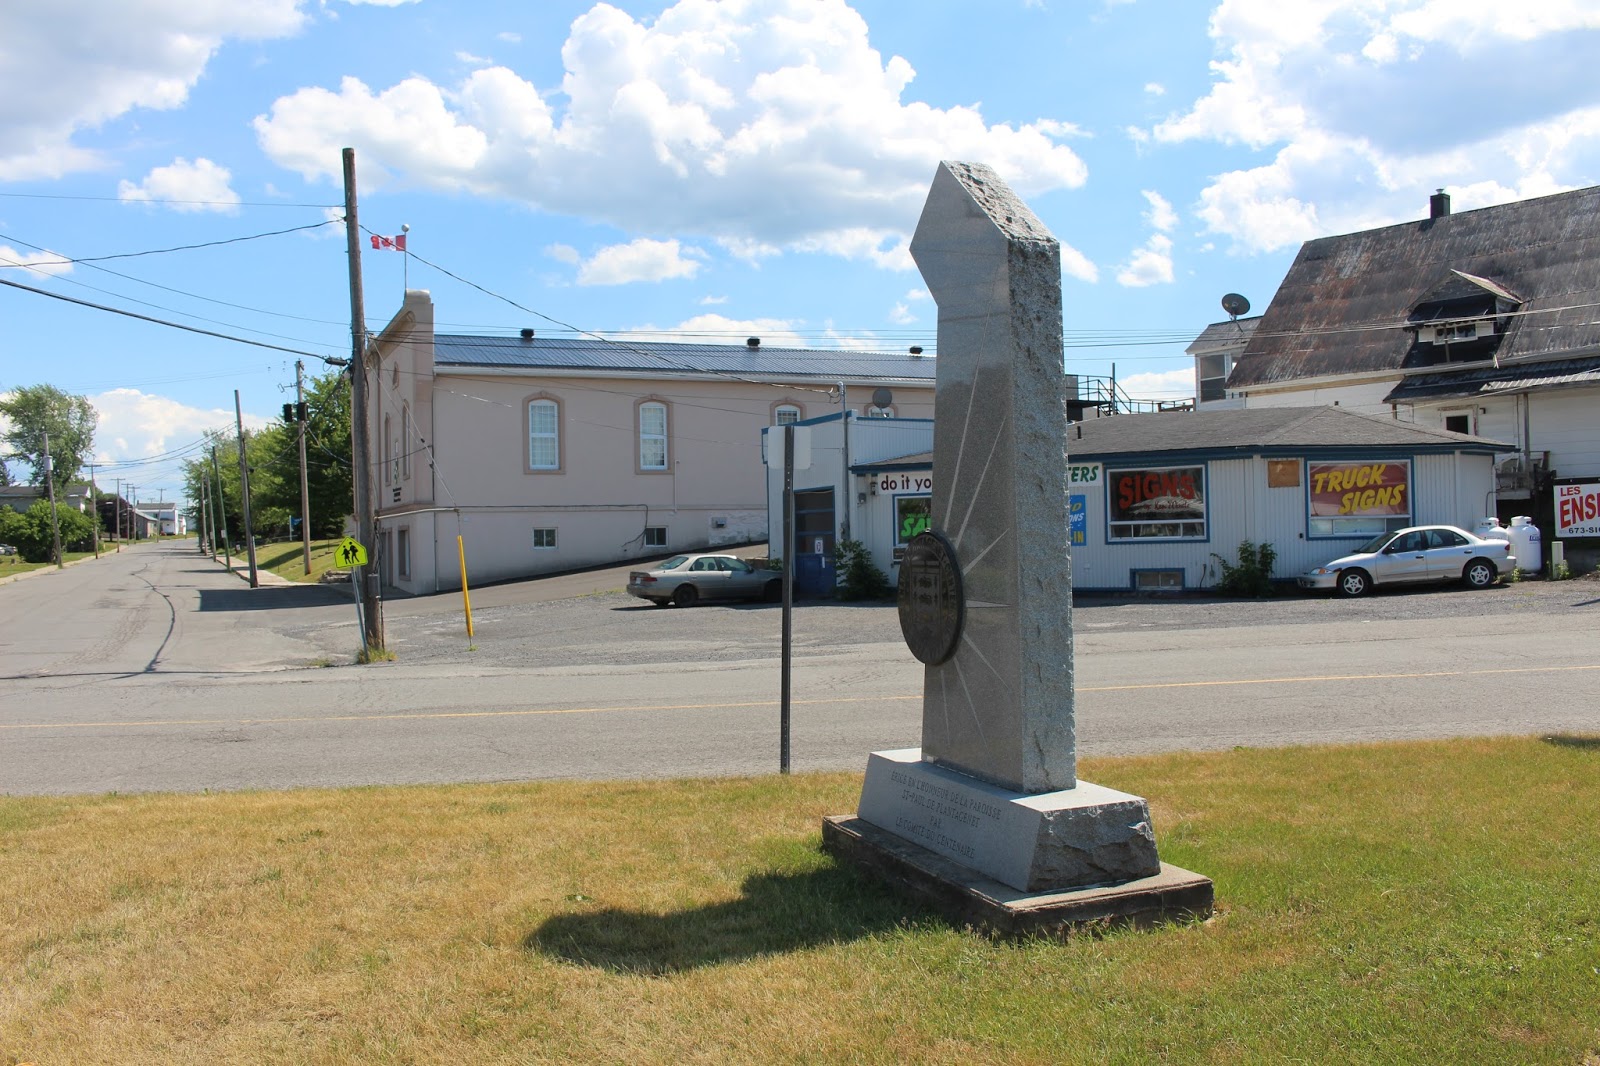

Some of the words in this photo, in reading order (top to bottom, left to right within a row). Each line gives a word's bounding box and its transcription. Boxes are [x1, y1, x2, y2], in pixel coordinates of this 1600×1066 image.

[881, 474, 898, 491] do
[901, 474, 910, 490] it
[914, 478, 932, 492] yo
[1068, 465, 1099, 482] ERS
[1314, 464, 1386, 494] TRUCK
[1118, 472, 1195, 510] SIGNS
[1338, 484, 1405, 514] SIGNS
[1560, 486, 1581, 497] LES
[1568, 526, 1600, 534] 673-SI
[927, 798, 935, 810] DE
[935, 802, 981, 828] PLANTAGENET
[950, 791, 959, 804] DE
[960, 794, 968, 807] LA
[969, 798, 1002, 820] PAROISSE
[930, 815, 942, 828] PAR
